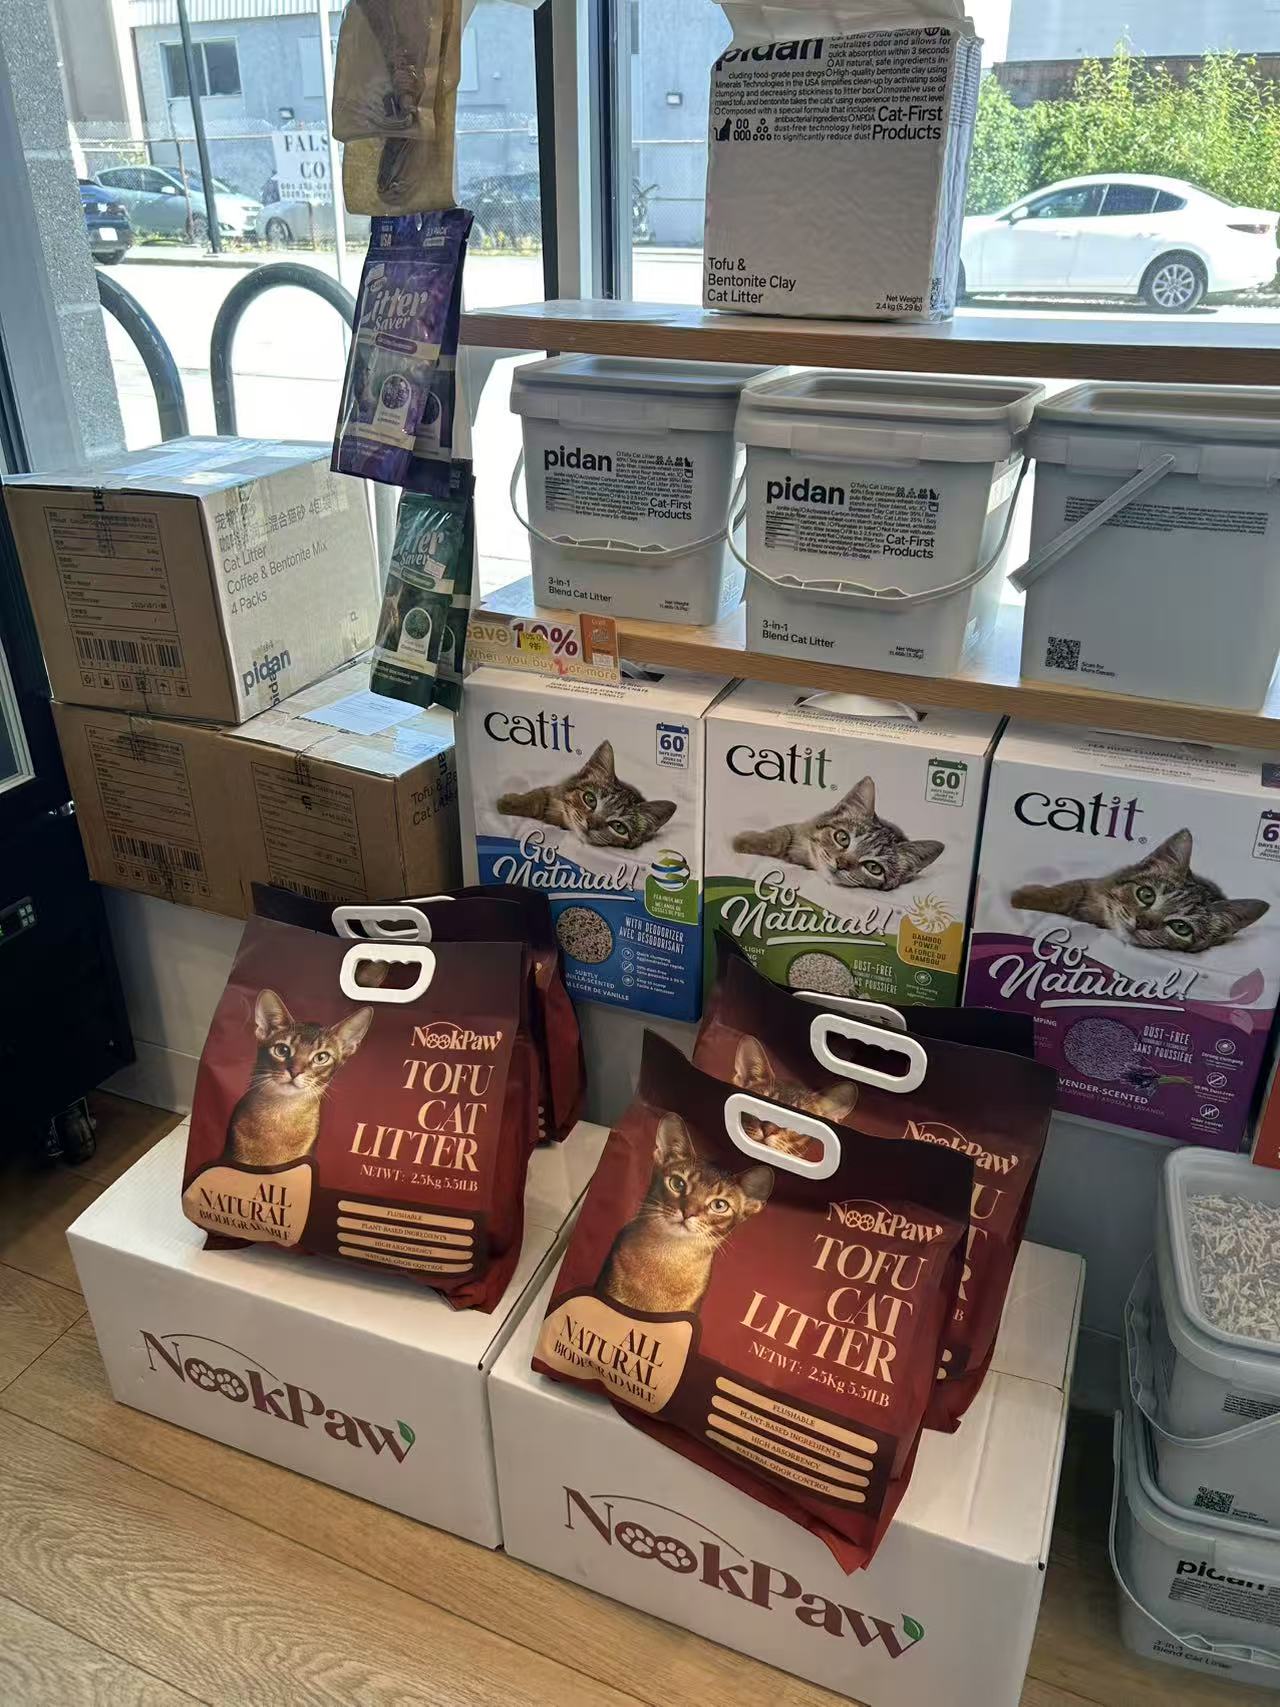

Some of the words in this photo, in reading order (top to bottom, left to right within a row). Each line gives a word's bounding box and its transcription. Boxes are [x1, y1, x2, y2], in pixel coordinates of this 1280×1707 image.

[828, 50, 846, 59] quick
[848, 48, 887, 58] absorption
[887, 47, 910, 56] within
[918, 46, 950, 54] seconds
[829, 40, 871, 49] neutralizes
[873, 39, 891, 47] odor
[893, 38, 908, 46] and
[911, 37, 936, 46] allows
[939, 37, 951, 45] for
[875, 57, 891, 66] safe
[893, 56, 936, 67] ingredients
[728, 72, 752, 80] cluding
[753, 70, 791, 80] food-grade
[805, 69, 825, 79] dregs
[876, 67, 910, 76] bentonite
[911, 66, 926, 75] clay
[927, 66, 948, 75] using
[743, 80, 784, 89] Technologies
[804, 78, 820, 86] USA
[853, 77, 884, 86] clean-up
[893, 76, 928, 85] activating
[929, 75, 947, 83] solid
[714, 89, 745, 98] clumping
[760, 88, 797, 97] decreasing
[760, 97, 789, 105] bentonite
[721, 107, 757, 116] Composed
[779, 106, 803, 115] special
[803, 105, 829, 114] formula
[846, 105, 876, 113] includes
[877, 104, 944, 122] Cat-First
[782, 132, 826, 142] significantly
[826, 131, 853, 140] reduce
[854, 131, 871, 140] dust
[808, 123, 850, 133] technology
[851, 122, 871, 131] helps
[871, 123, 942, 141] Products
[708, 257, 734, 271] Tofu
[737, 257, 746, 271] &
[708, 273, 767, 288] Bentonite
[769, 275, 797, 292] Clay
[707, 288, 727, 302] Cat
[731, 289, 764, 304] Litter
[899, 294, 924, 304] Weight
[374, 315, 412, 332] Saver
[544, 445, 613, 472] pidan
[766, 476, 846, 505] pidan
[648, 508, 692, 520] Products
[650, 498, 692, 510] Cat-First
[886, 533, 935, 548] Cat-First
[223, 557, 242, 574] Cat
[243, 544, 267, 566] Litter
[882, 545, 934, 559] Products
[227, 572, 259, 595] Coffee
[261, 565, 268, 579] &
[269, 549, 311, 576] Bentonite
[312, 541, 328, 556] Mix
[548, 577, 571, 588] 3-in-1
[231, 602, 239, 616] 4
[240, 590, 268, 612] Packs
[548, 586, 572, 597] Blend
[573, 589, 588, 600] Cat
[589, 591, 612, 602] Litter
[762, 620, 788, 632] 3-in-1
[762, 629, 789, 642] Blend
[791, 633, 807, 645] Cat
[809, 635, 835, 648] Litter
[242, 649, 292, 697] pidan
[467, 649, 499, 662] When
[503, 655, 527, 668] you
[532, 655, 554, 673] buy
[569, 664, 582, 675] or
[587, 667, 617, 681] more
[484, 710, 578, 753] catit
[659, 733, 685, 752] 60
[726, 743, 832, 789] catit
[931, 770, 960, 790] 60
[1014, 792, 1145, 842] catit
[519, 828, 559, 864] Go
[492, 856, 640, 893] Natural!
[753, 870, 800, 906] Go
[720, 895, 894, 939] Natural!
[619, 926, 634, 940] AVEC
[625, 916, 642, 930] WITH
[645, 922, 684, 943] DEODORIZER
[911, 933, 942, 945] BAMBOO
[904, 946, 913, 954] LA
[913, 947, 934, 959] FORCE
[935, 952, 946, 961] DU
[913, 940, 940, 950] POWER
[1031, 927, 1089, 966] Go
[853, 959, 893, 977] DUST-FREE
[910, 954, 940, 966] BAMBOU
[988, 954, 1200, 1001] Natural!
[603, 990, 630, 1001] VANILLE
[411, 1023, 503, 1051] NookPaw
[1143, 1025, 1191, 1046] DUST-FREE
[1132, 1042, 1154, 1057] SANS
[402, 1059, 495, 1097] TOFU
[417, 1099, 488, 1136] CAT
[349, 1122, 480, 1172] LITTER
[410, 1172, 442, 1190] 2.5Kg
[443, 1177, 479, 1192] 5.51LB
[252, 1182, 292, 1209] ALL
[200, 1187, 292, 1229] NATURAL
[386, 1210, 423, 1221] FLUSHABLE
[199, 1210, 292, 1242] BIODEGRADABLE
[826, 1200, 944, 1243] NookPaw
[361, 1223, 404, 1235] PLANT-BASED
[404, 1229, 448, 1241] INGREDIENTS
[374, 1241, 391, 1249] HIGH
[412, 1262, 444, 1271] CONTROL
[812, 1234, 928, 1291] TOFU
[826, 1286, 914, 1339] CAT
[619, 1327, 664, 1368] ALL
[739, 1290, 895, 1385] LITTER
[560, 1314, 658, 1390] NATURAL
[554, 1339, 656, 1404] BIODEGRADABLE
[140, 1329, 416, 1464] NookPaw
[808, 1366, 845, 1394] 2.5Kg
[847, 1382, 890, 1408] 5.51LB
[772, 1404, 816, 1427] FLUSHABLE
[739, 1409, 790, 1437] PLANT-BASED
[790, 1432, 842, 1459] INGREDIENTS
[751, 1435, 771, 1449] HIGH
[772, 1445, 821, 1470] ABSORBENCY
[736, 1445, 769, 1468] NATURAL
[769, 1463, 793, 1477] ODOR
[793, 1471, 831, 1493] CONTROL
[562, 1485, 925, 1660] NookPaw
